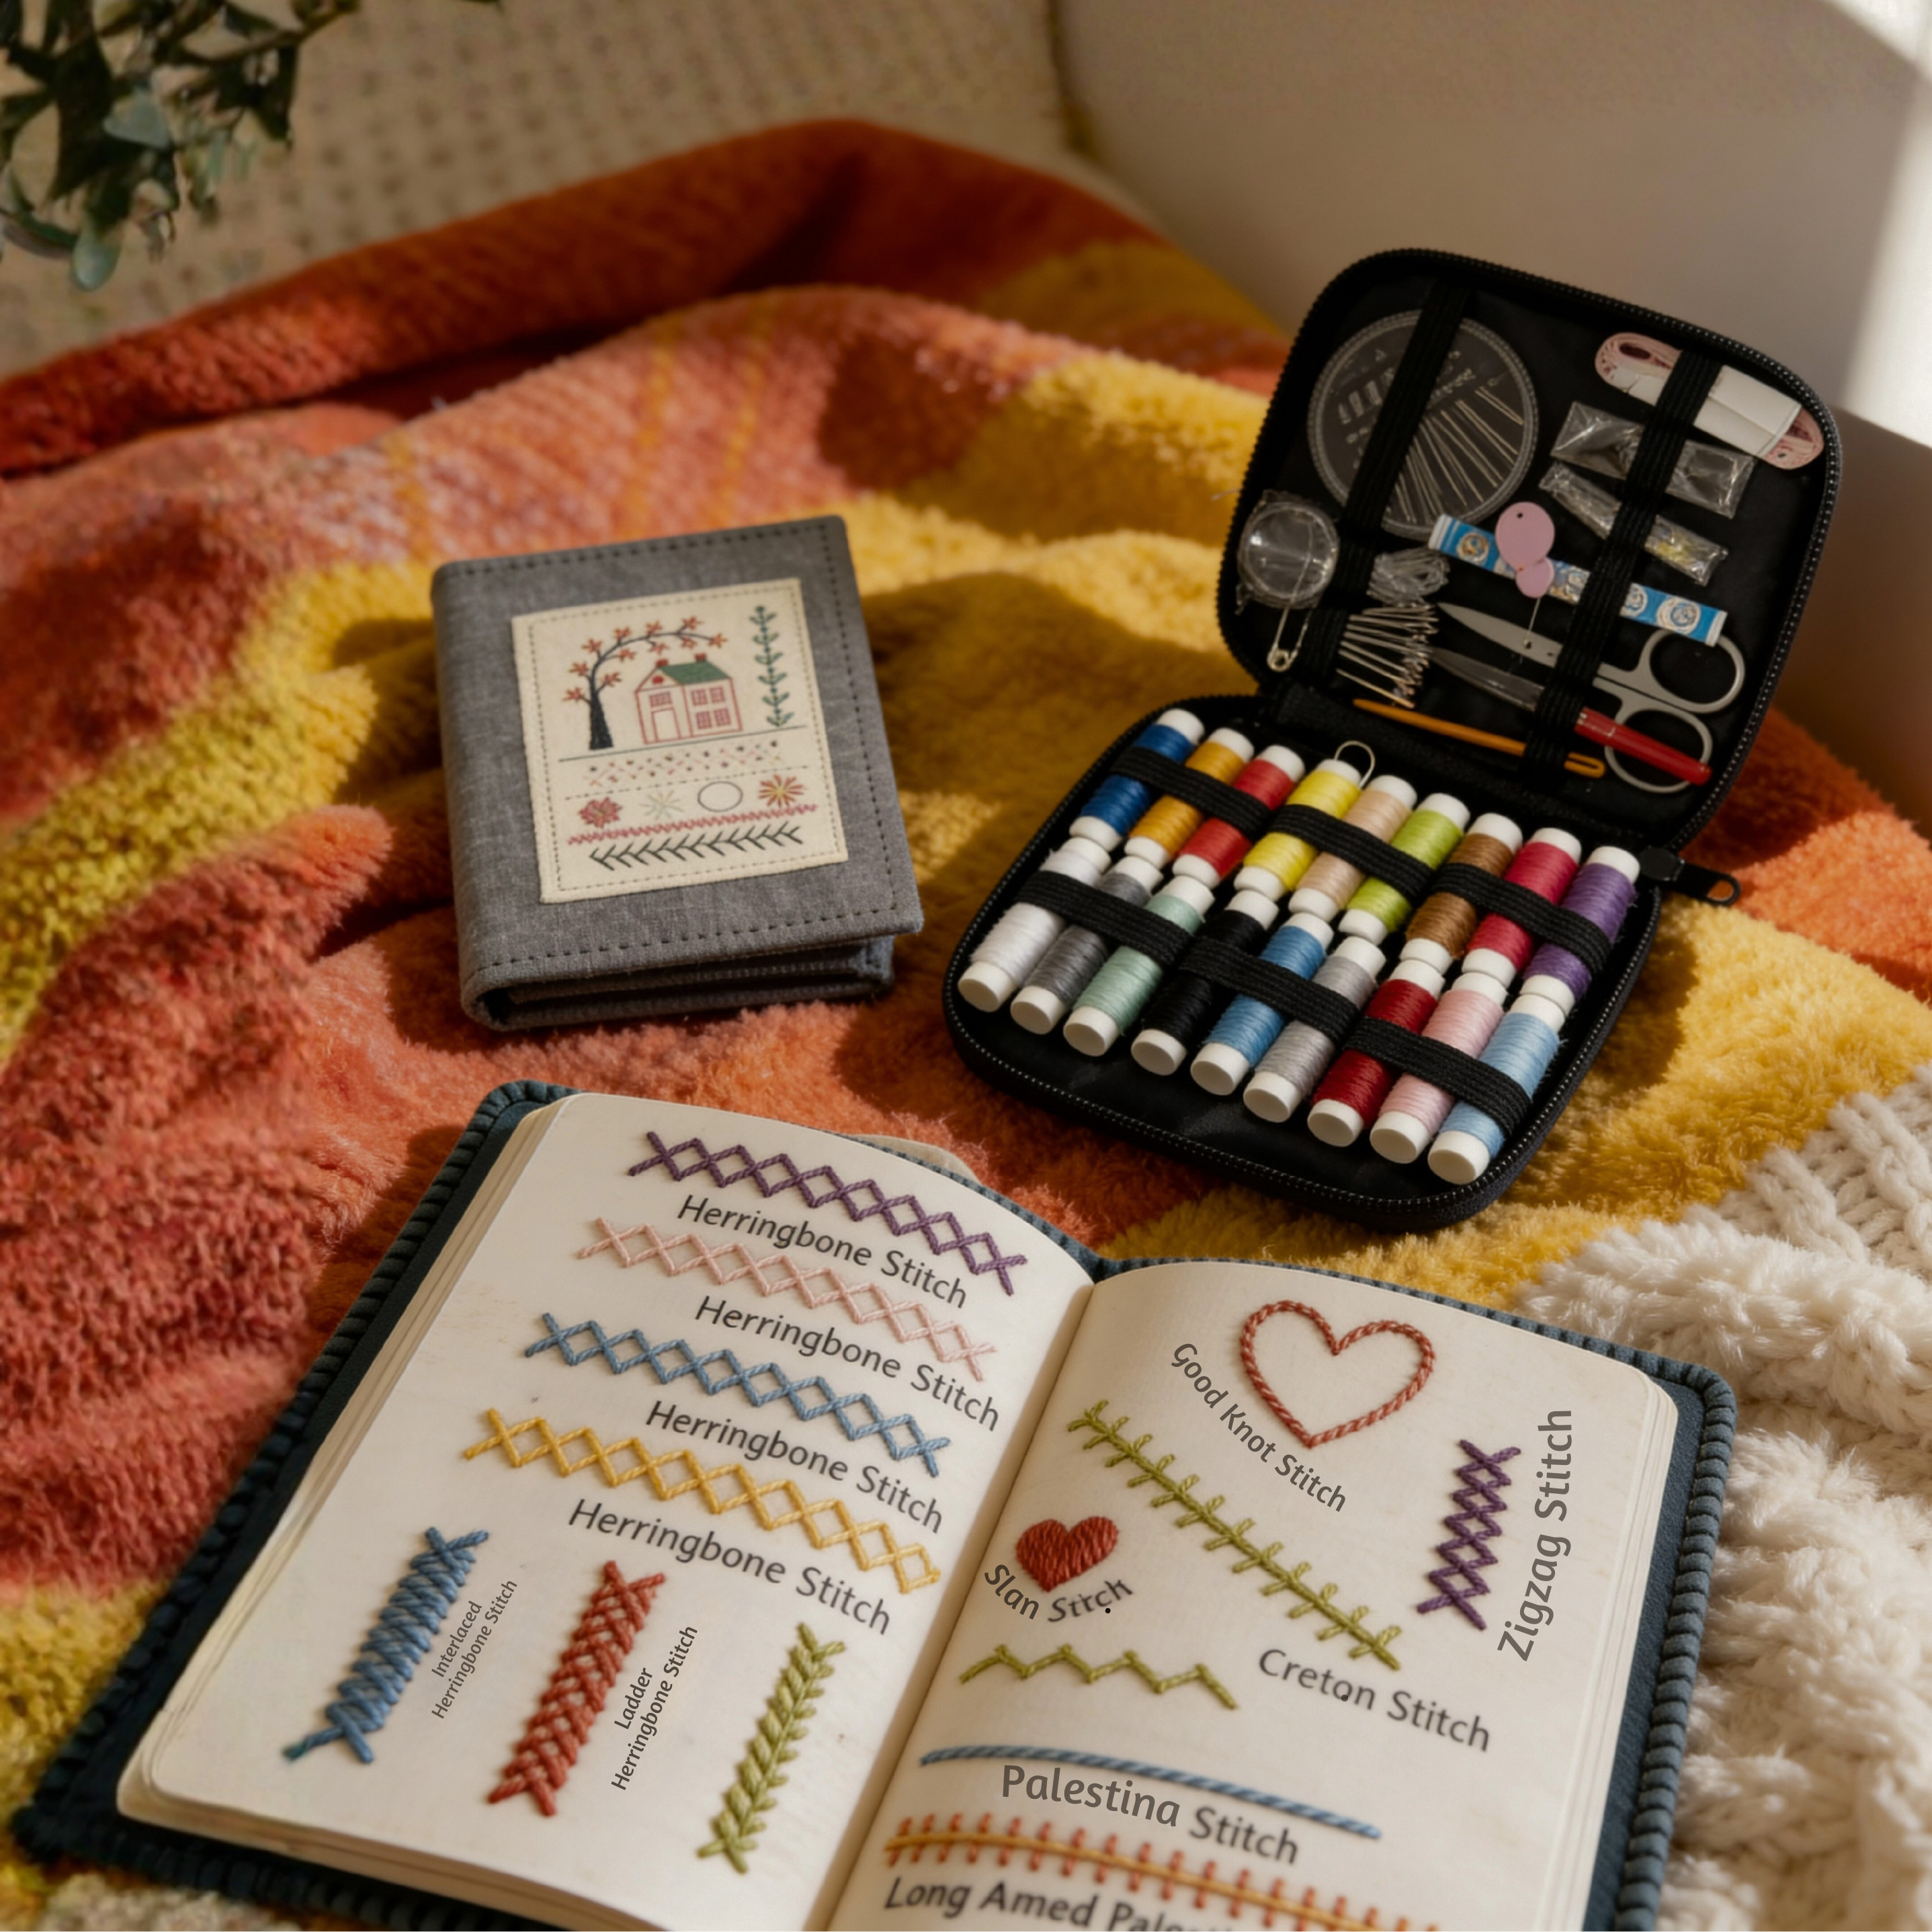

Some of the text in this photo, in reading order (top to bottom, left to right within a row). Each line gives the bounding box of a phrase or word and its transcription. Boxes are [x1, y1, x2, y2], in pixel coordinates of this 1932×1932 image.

[677, 1194, 967, 1309] Herringbone Stitch
[695, 1296, 999, 1432] Herringbone Stitch
[645, 1400, 943, 1534] Herringbone Stitch
[1171, 1343, 1346, 1513] Good Knot Stitch
[568, 1499, 891, 1636] Herringbone Stitch
[984, 1564, 1040, 1620] Slan
[1497, 1410, 1572, 1662] Zigzag Stitch
[431, 1600, 482, 1678] Interlaced
[431, 1579, 518, 1720] Herringbone Stitch
[614, 1667, 653, 1730] Ladder
[1258, 1648, 1491, 1753] Creton Stitch
[611, 1626, 698, 1791] Herringbone Stitch
[1002, 1765, 1299, 1865] Palestina Stitch
[884, 1876, 972, 1919] Long
[978, 1880, 1099, 1927] Amed
